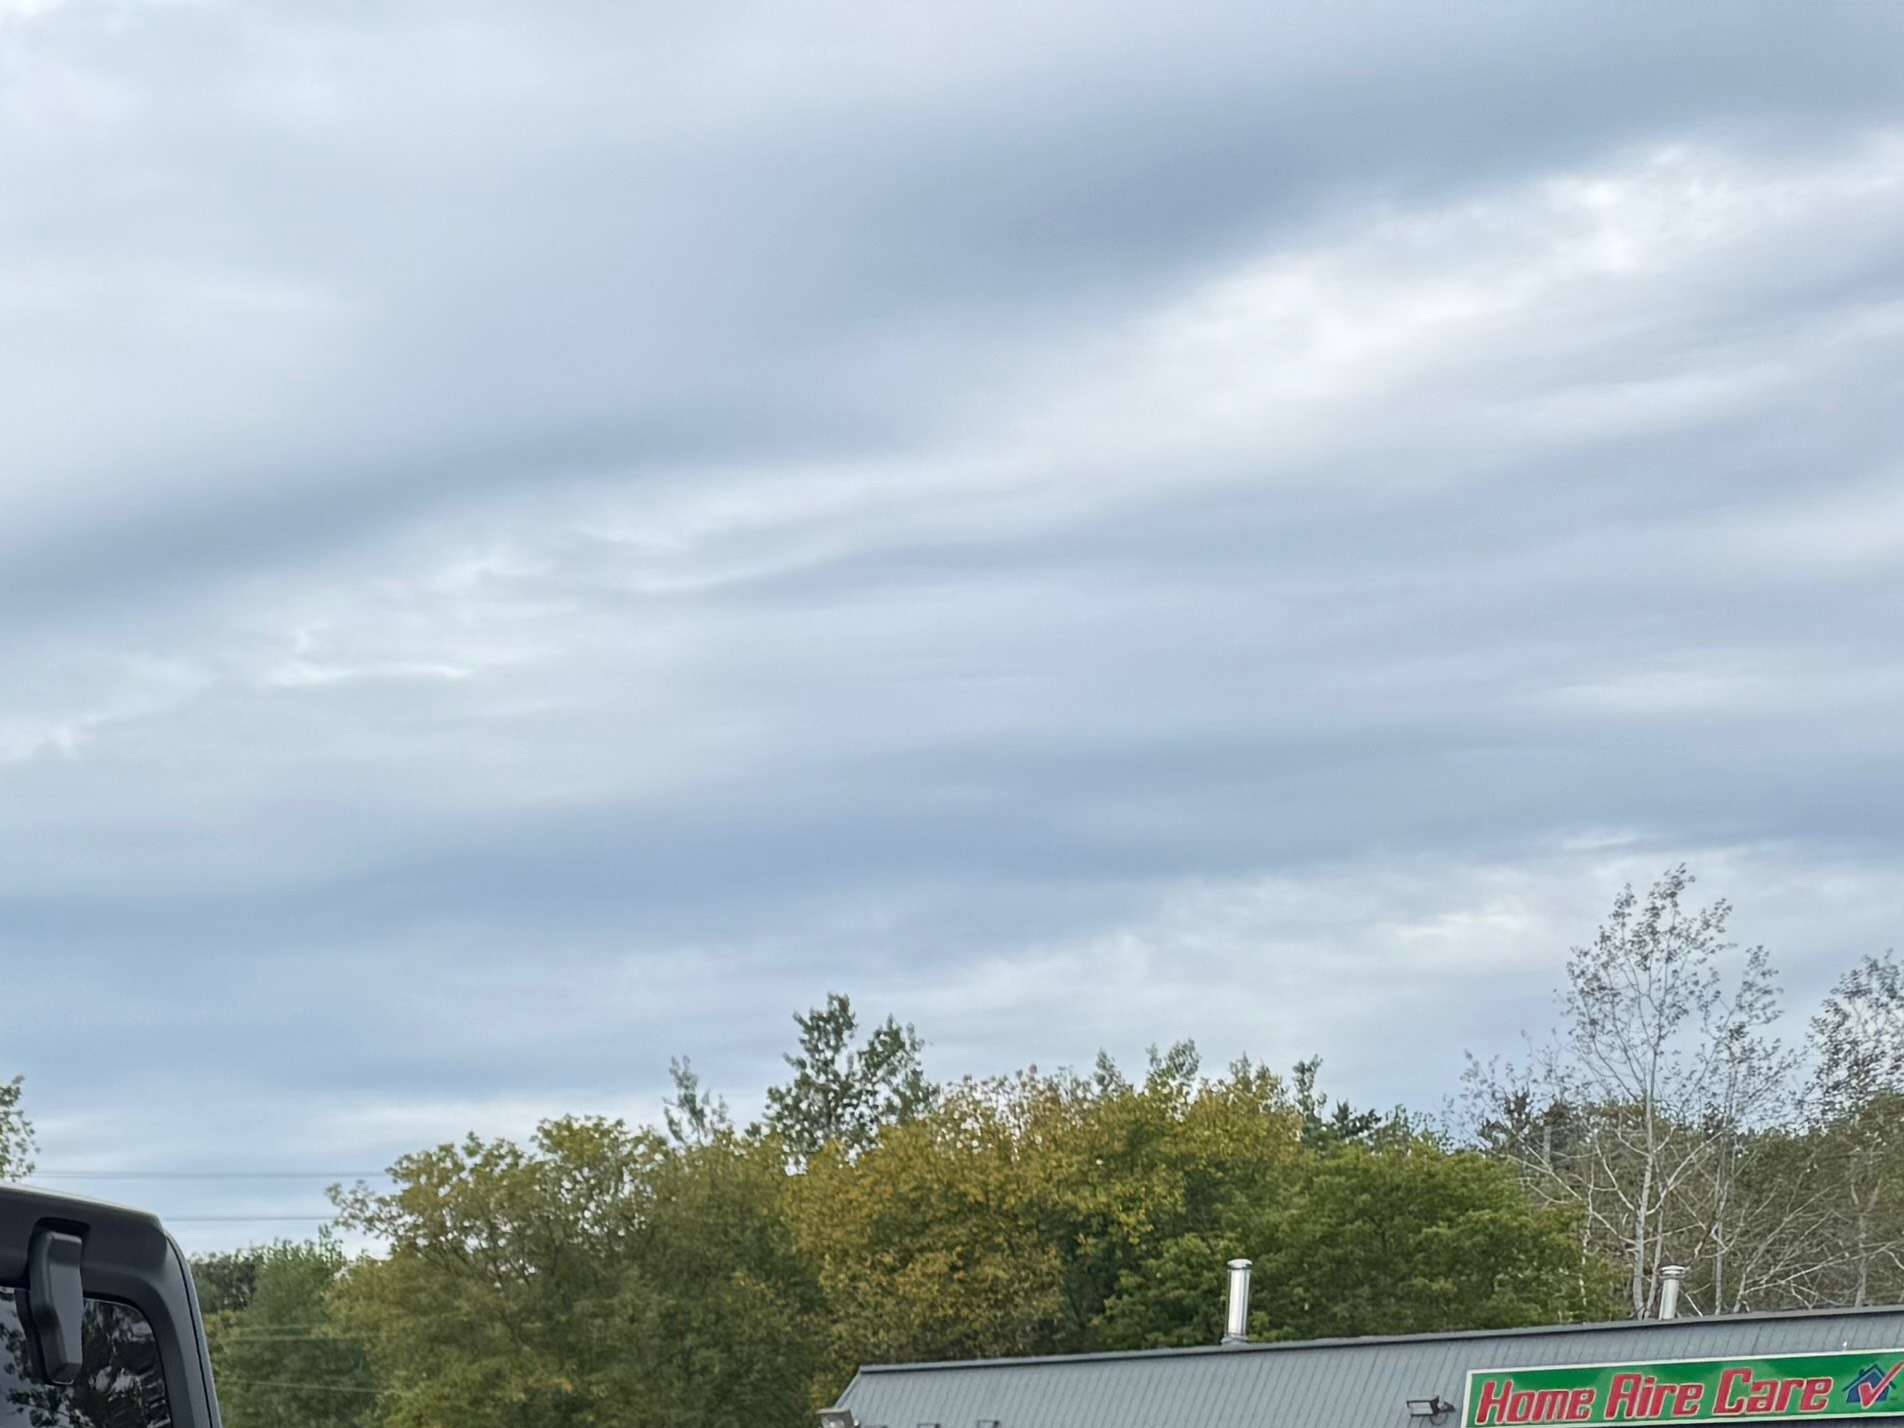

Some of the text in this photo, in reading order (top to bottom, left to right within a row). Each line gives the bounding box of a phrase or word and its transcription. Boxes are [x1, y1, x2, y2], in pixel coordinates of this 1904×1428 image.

[1475, 1367, 1834, 1424] Home Aire Care
